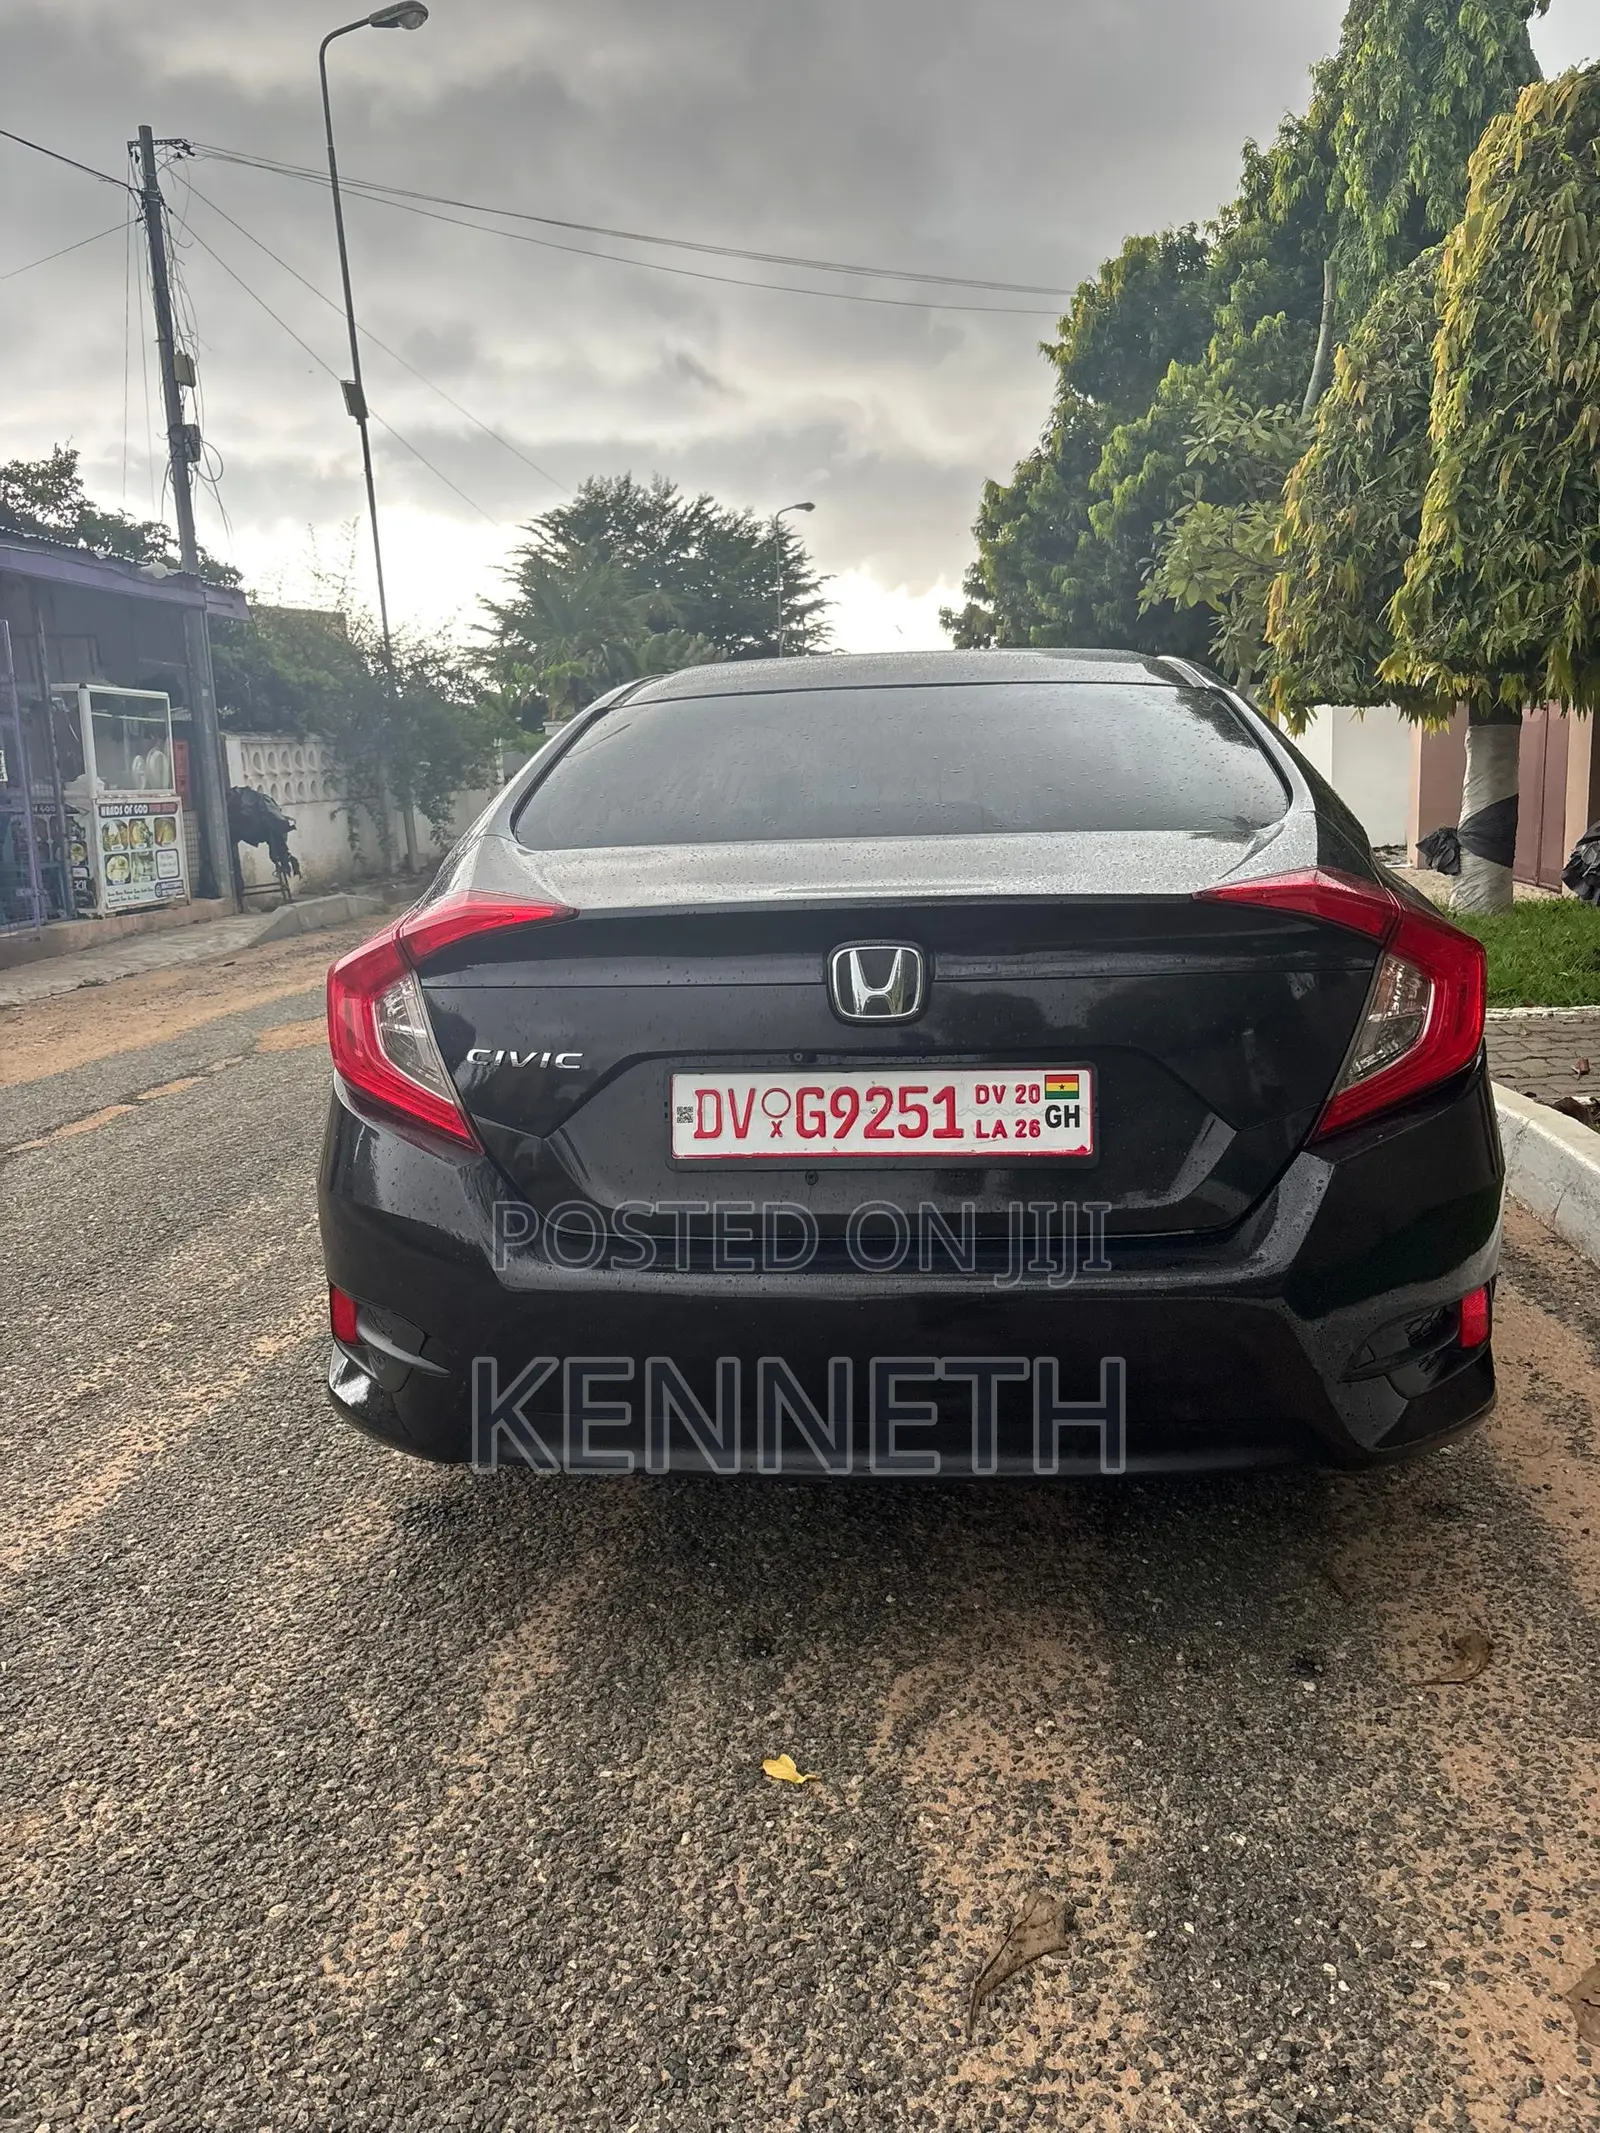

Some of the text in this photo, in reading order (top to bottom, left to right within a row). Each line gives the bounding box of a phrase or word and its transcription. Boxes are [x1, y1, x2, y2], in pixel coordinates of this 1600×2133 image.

[466, 1048, 584, 1069] CIVIC
[974, 1084, 1041, 1105] DV 20
[693, 1085, 965, 1140] DV G9251
[1044, 1104, 1081, 1129] GH
[974, 1119, 1041, 1140] LA 26
